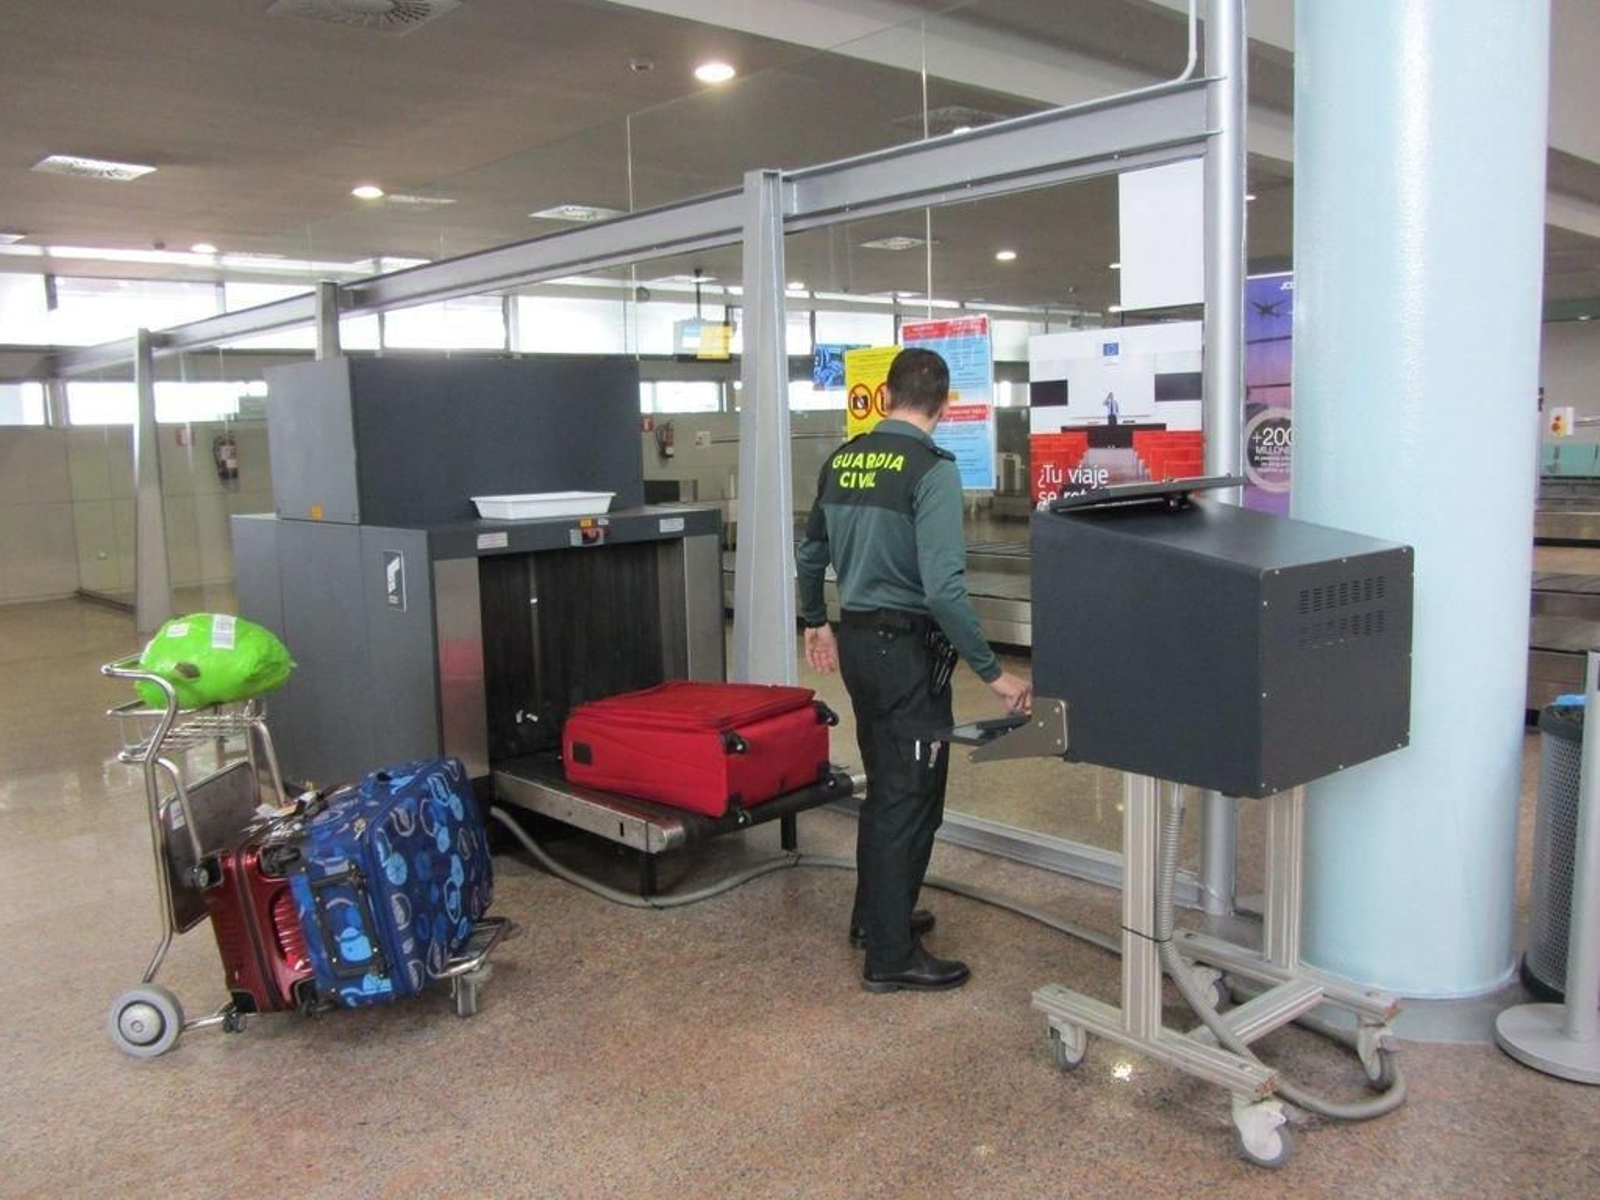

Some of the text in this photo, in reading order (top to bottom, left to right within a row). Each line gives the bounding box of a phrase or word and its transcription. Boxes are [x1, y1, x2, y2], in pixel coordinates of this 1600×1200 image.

[832, 453, 904, 471] GUARDIA
[840, 472, 876, 489] CIVIL
[1037, 464, 1109, 489] ¿Tu viaje
